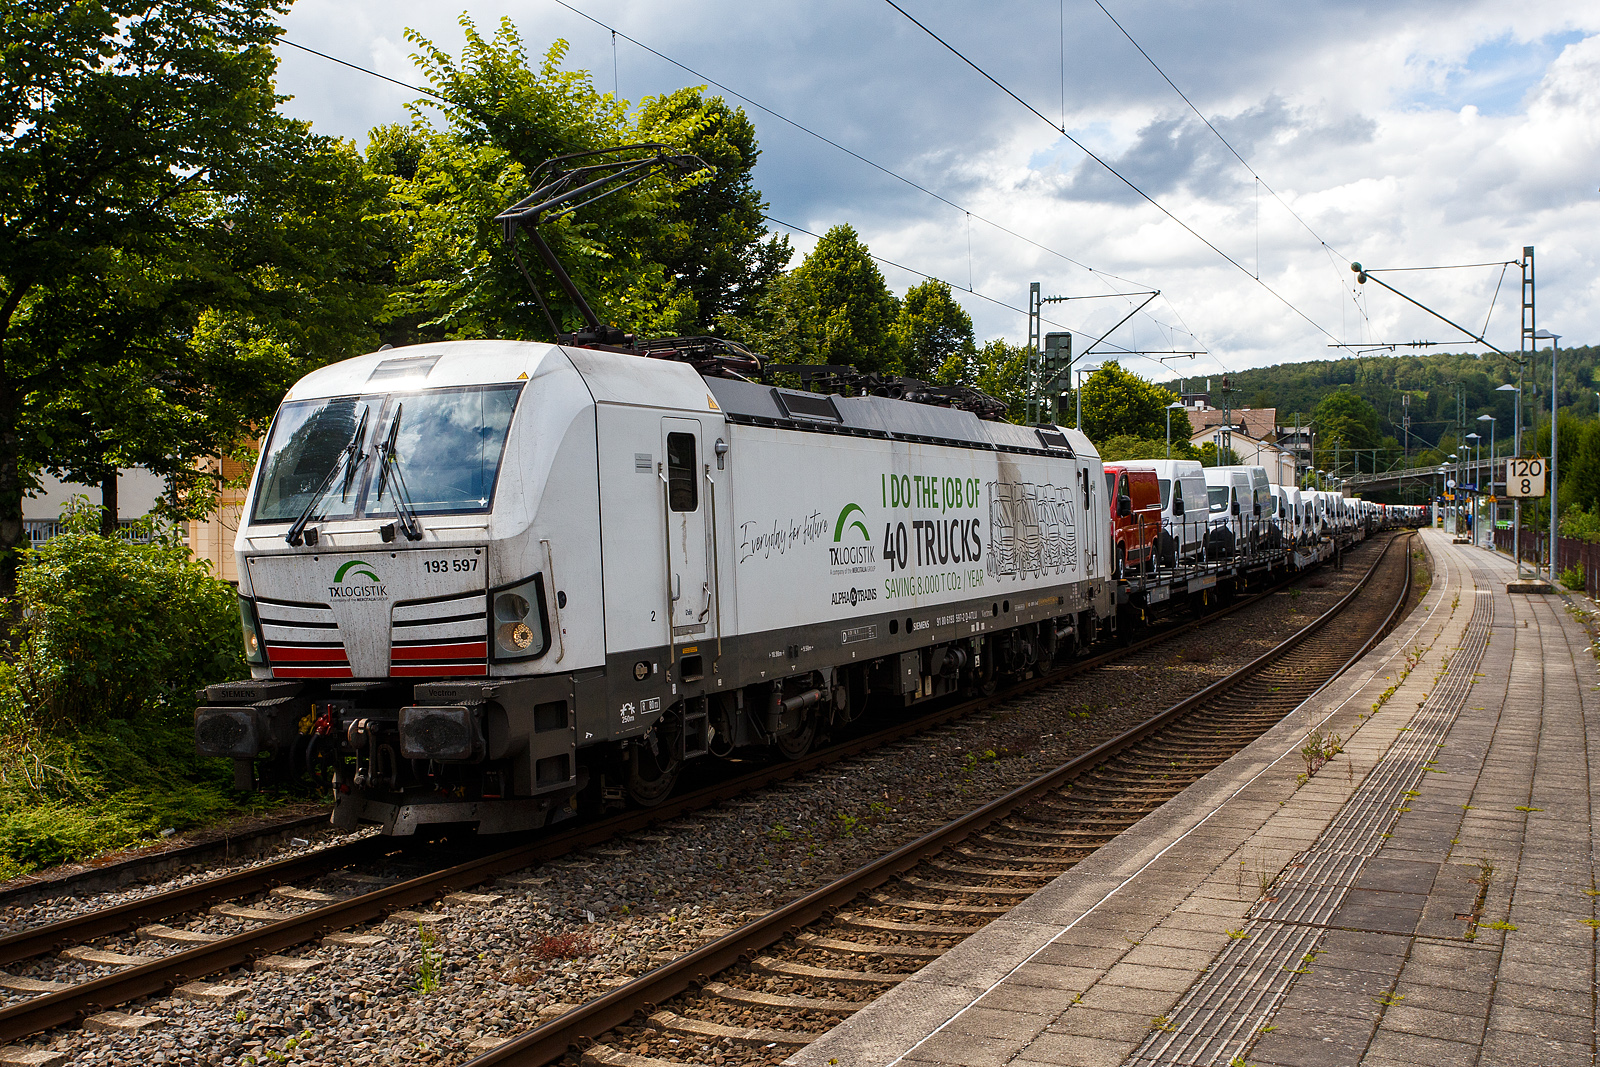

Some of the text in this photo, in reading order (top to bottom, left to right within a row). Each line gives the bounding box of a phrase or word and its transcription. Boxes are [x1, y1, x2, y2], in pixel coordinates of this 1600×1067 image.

[1510, 460, 1542, 477] 120
[882, 474, 980, 515] I DO THE JOB OF
[1520, 479, 1531, 494] 8
[740, 520, 787, 564] Everyday
[883, 518, 981, 572] 40 TRUCKS
[424, 558, 478, 573] 193 597
[885, 576, 916, 599] SAVING
[917, 575, 940, 595] 8.000
[941, 573, 945, 592] T
[967, 569, 984, 588] YEAR
[831, 588, 877, 605] ALPHA TRAINS
[650, 610, 656, 622] 2
[913, 620, 930, 631] SIEMENS
[221, 690, 256, 698] SIEMENS
